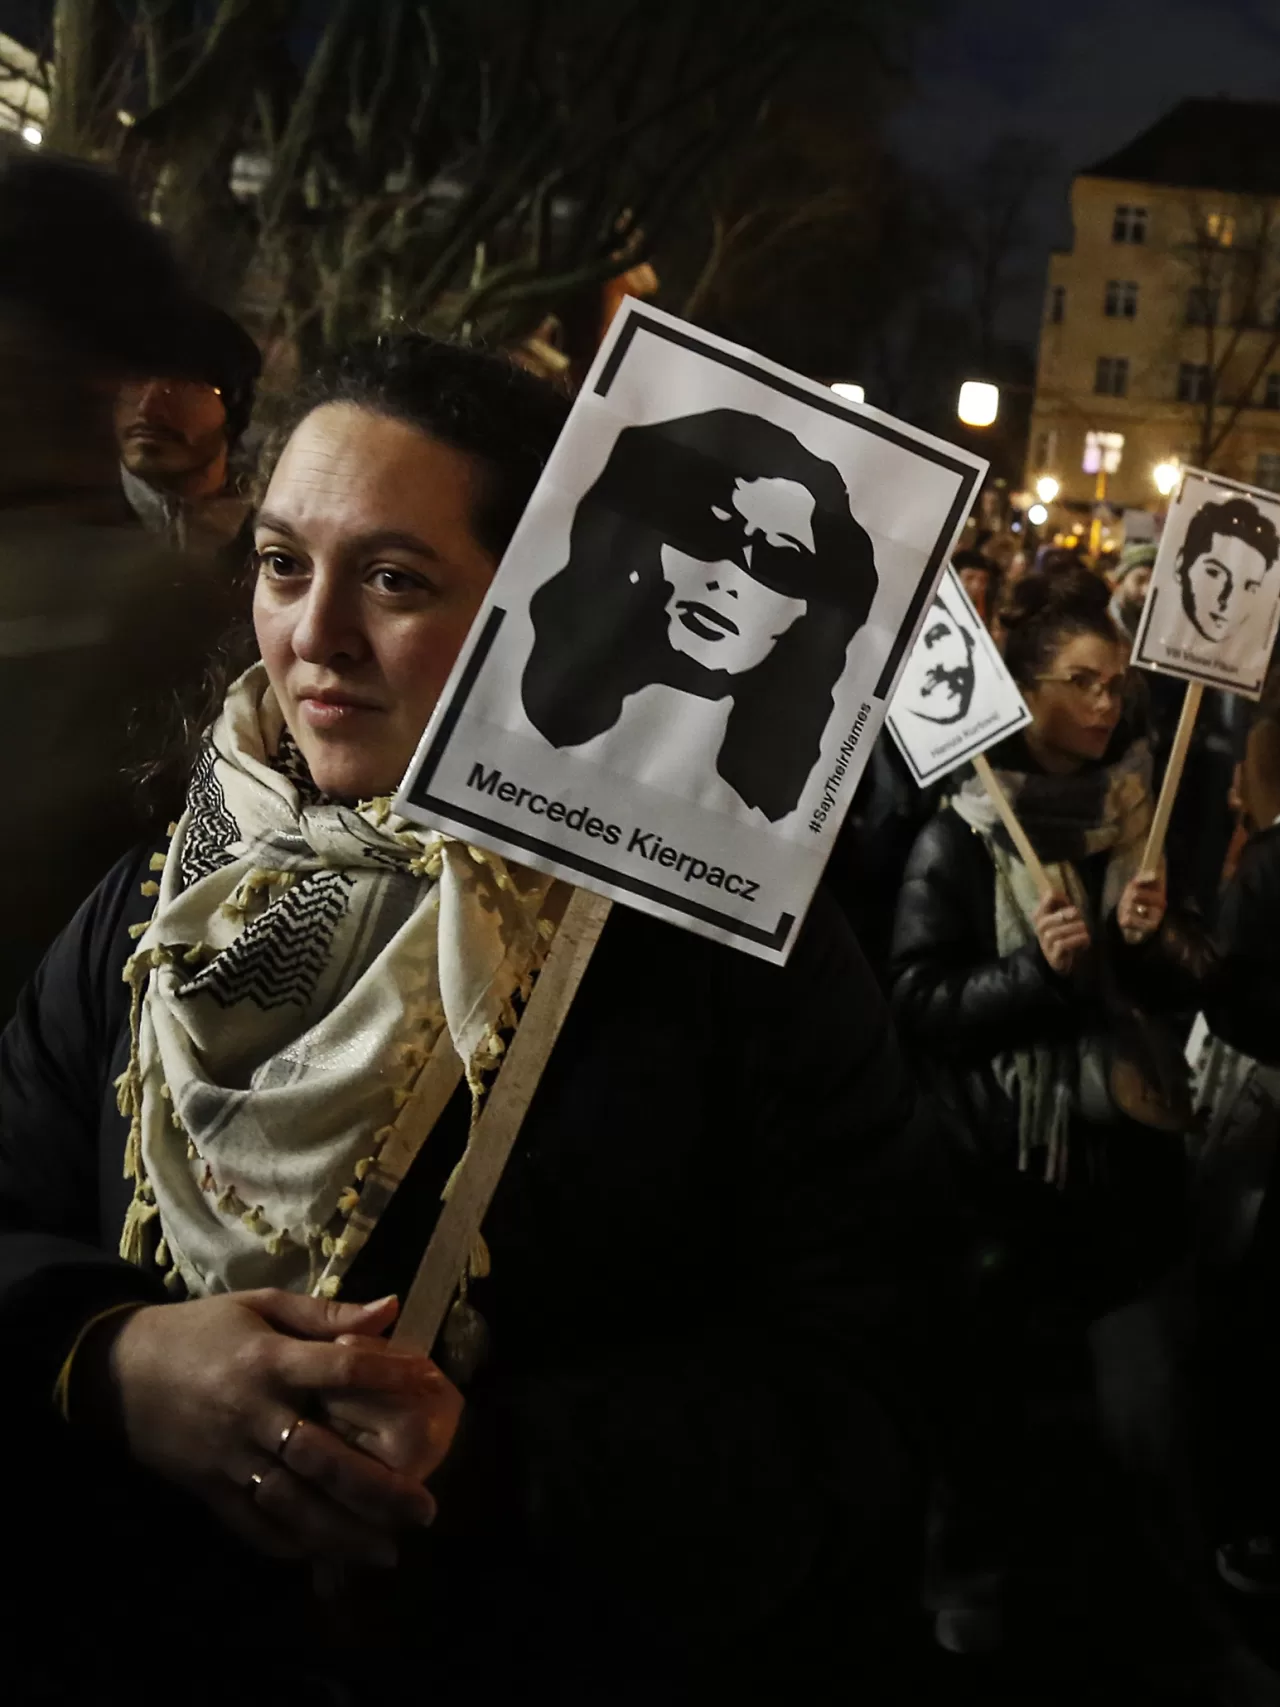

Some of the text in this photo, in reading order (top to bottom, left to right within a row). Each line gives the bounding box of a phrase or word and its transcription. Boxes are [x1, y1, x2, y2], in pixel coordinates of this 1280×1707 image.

[466, 762, 761, 902] Mercedes Kierpacz
[809, 703, 871, 834] #SayTheirNames
